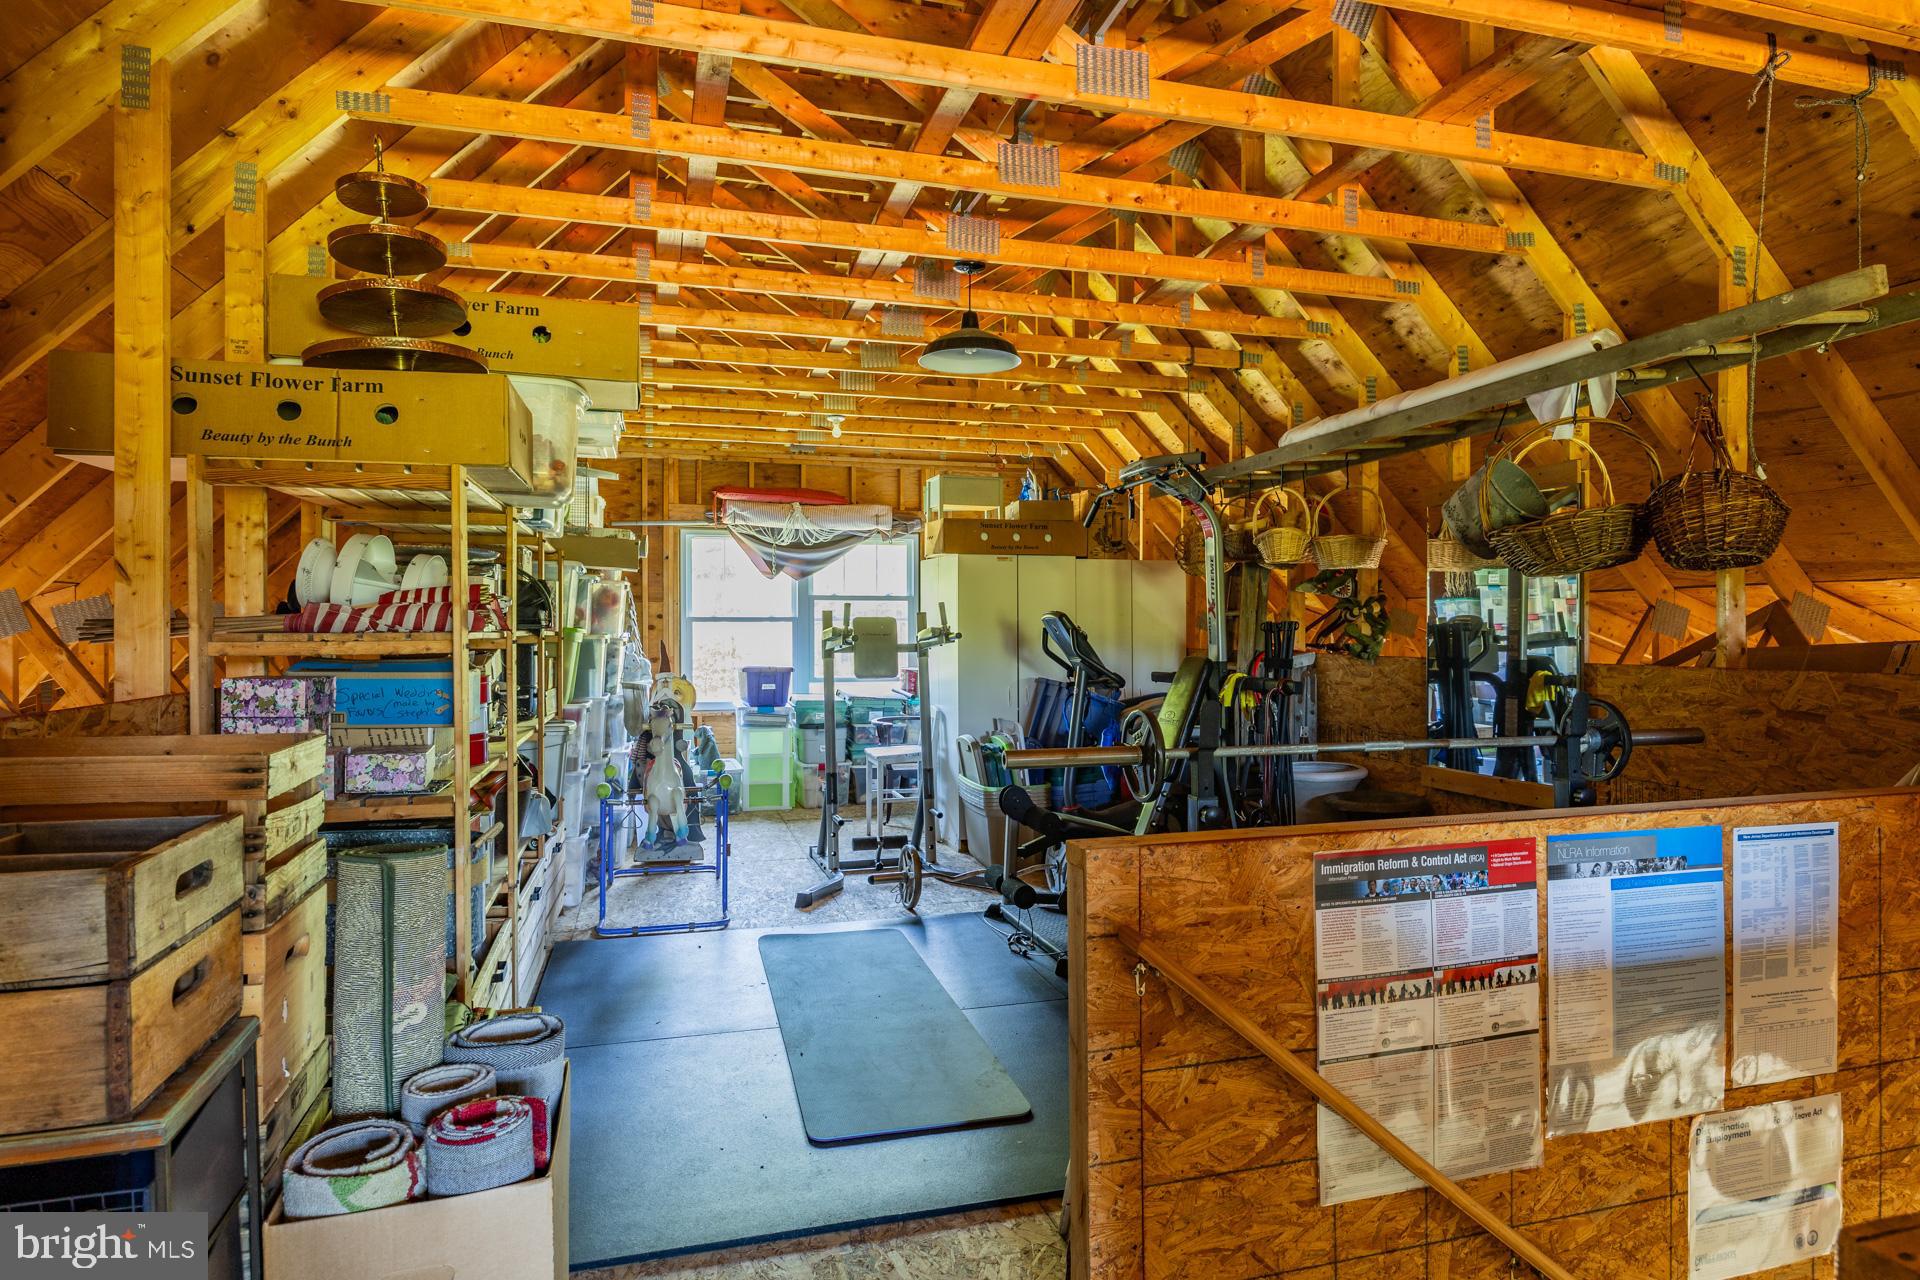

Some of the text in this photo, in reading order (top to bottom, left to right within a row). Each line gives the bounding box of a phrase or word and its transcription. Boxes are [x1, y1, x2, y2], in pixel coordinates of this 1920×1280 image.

[495, 301, 539, 316] Farm
[171, 366, 384, 393] Sunset Flower Farm
[201, 429, 352, 447] Beauty by the Bunch
[1558, 845, 1630, 859] NLRA Information
[1321, 852, 1485, 875] Immigration Reform & Control Act (IRCA)
[1813, 1108, 1823, 1116] Act
